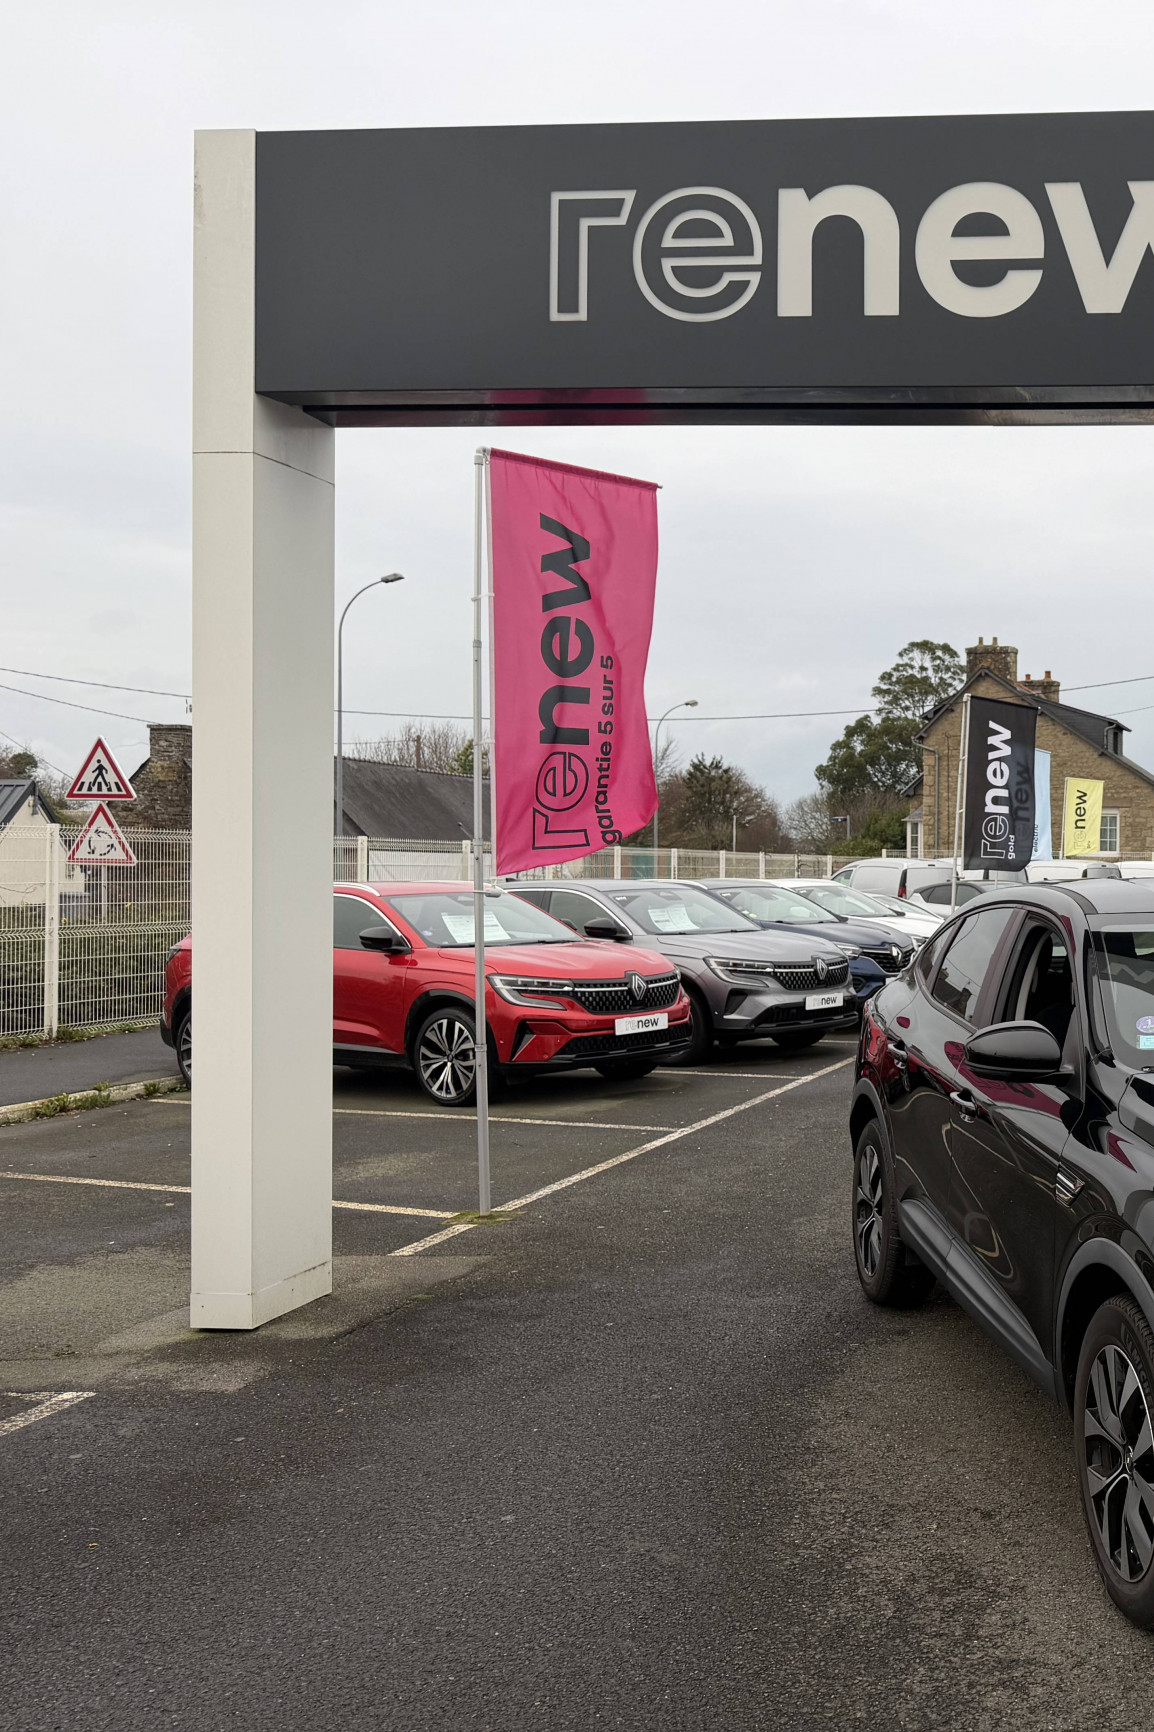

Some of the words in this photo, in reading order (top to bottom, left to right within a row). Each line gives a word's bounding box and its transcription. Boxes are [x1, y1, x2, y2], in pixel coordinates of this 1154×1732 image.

[532, 512, 595, 850] renew
[601, 655, 614, 670] 5
[602, 674, 614, 717] sur
[598, 721, 614, 735] 5
[595, 741, 622, 845] garantie
[981, 720, 1012, 859] renew
[1073, 789, 1088, 850] renew
[1007, 834, 1016, 859] gold
